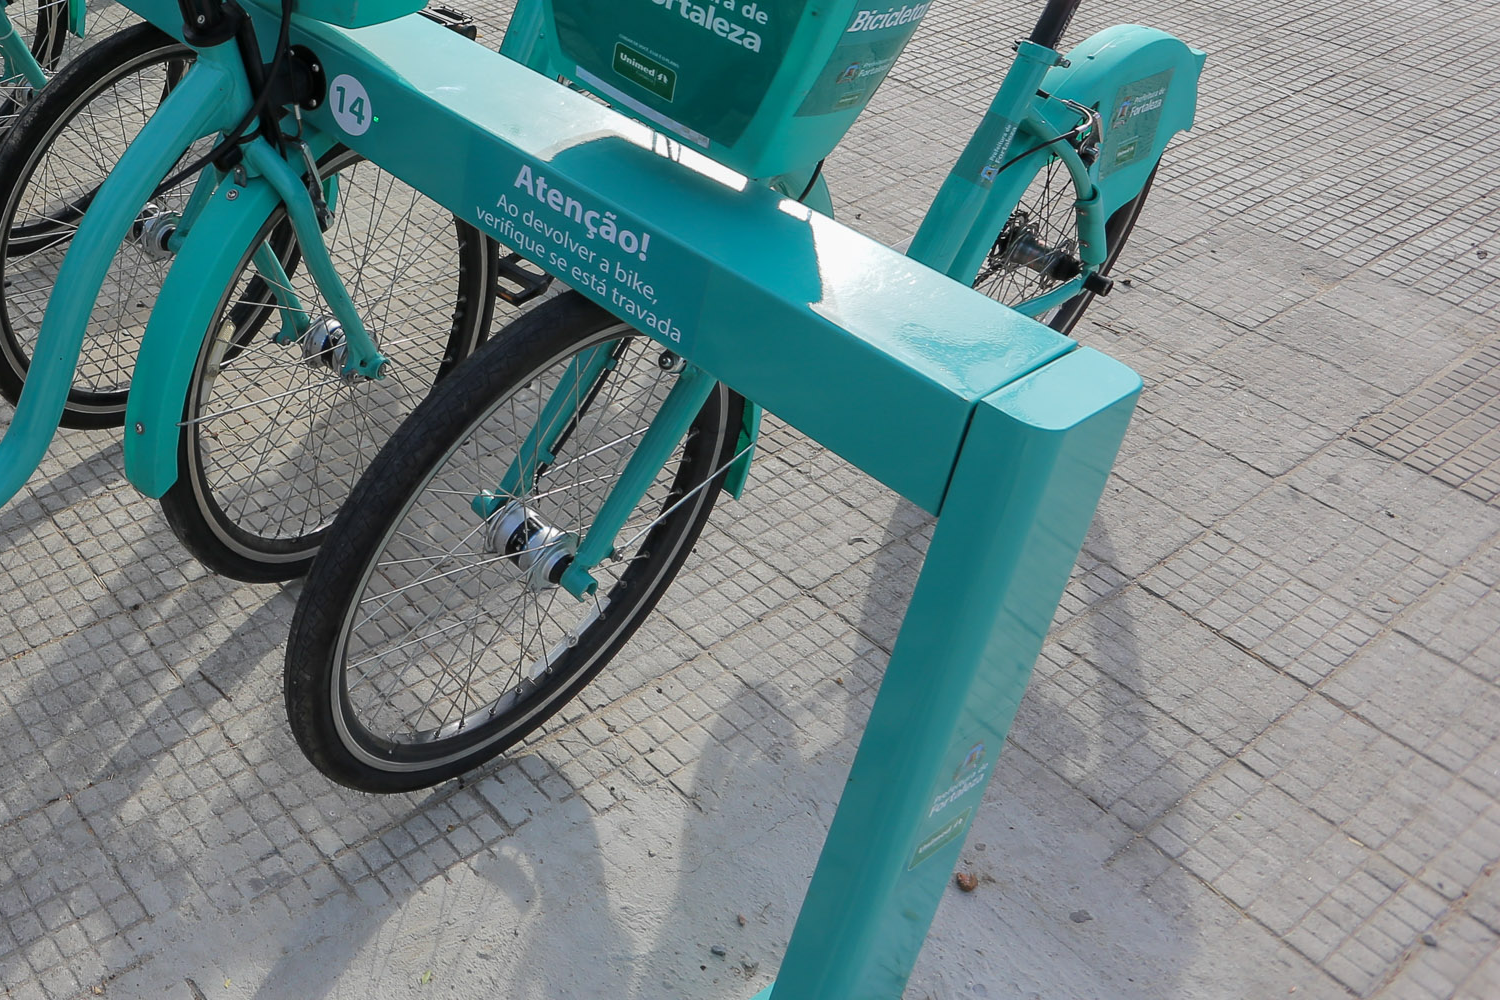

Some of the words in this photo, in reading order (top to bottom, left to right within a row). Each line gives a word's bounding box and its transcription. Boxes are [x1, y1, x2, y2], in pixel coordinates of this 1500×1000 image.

[741, 2, 769, 25] de
[620, 52, 655, 77] Unimed
[336, 86, 365, 126] 14
[513, 164, 651, 262] Atenção!
[476, 206, 546, 258] verifique
[549, 252, 568, 272] se
[571, 266, 607, 297] está
[612, 287, 682, 344] travada
[496, 193, 519, 217] Ao
[522, 209, 596, 263] devolver
[600, 258, 610, 274] a
[615, 262, 658, 305] bike,
